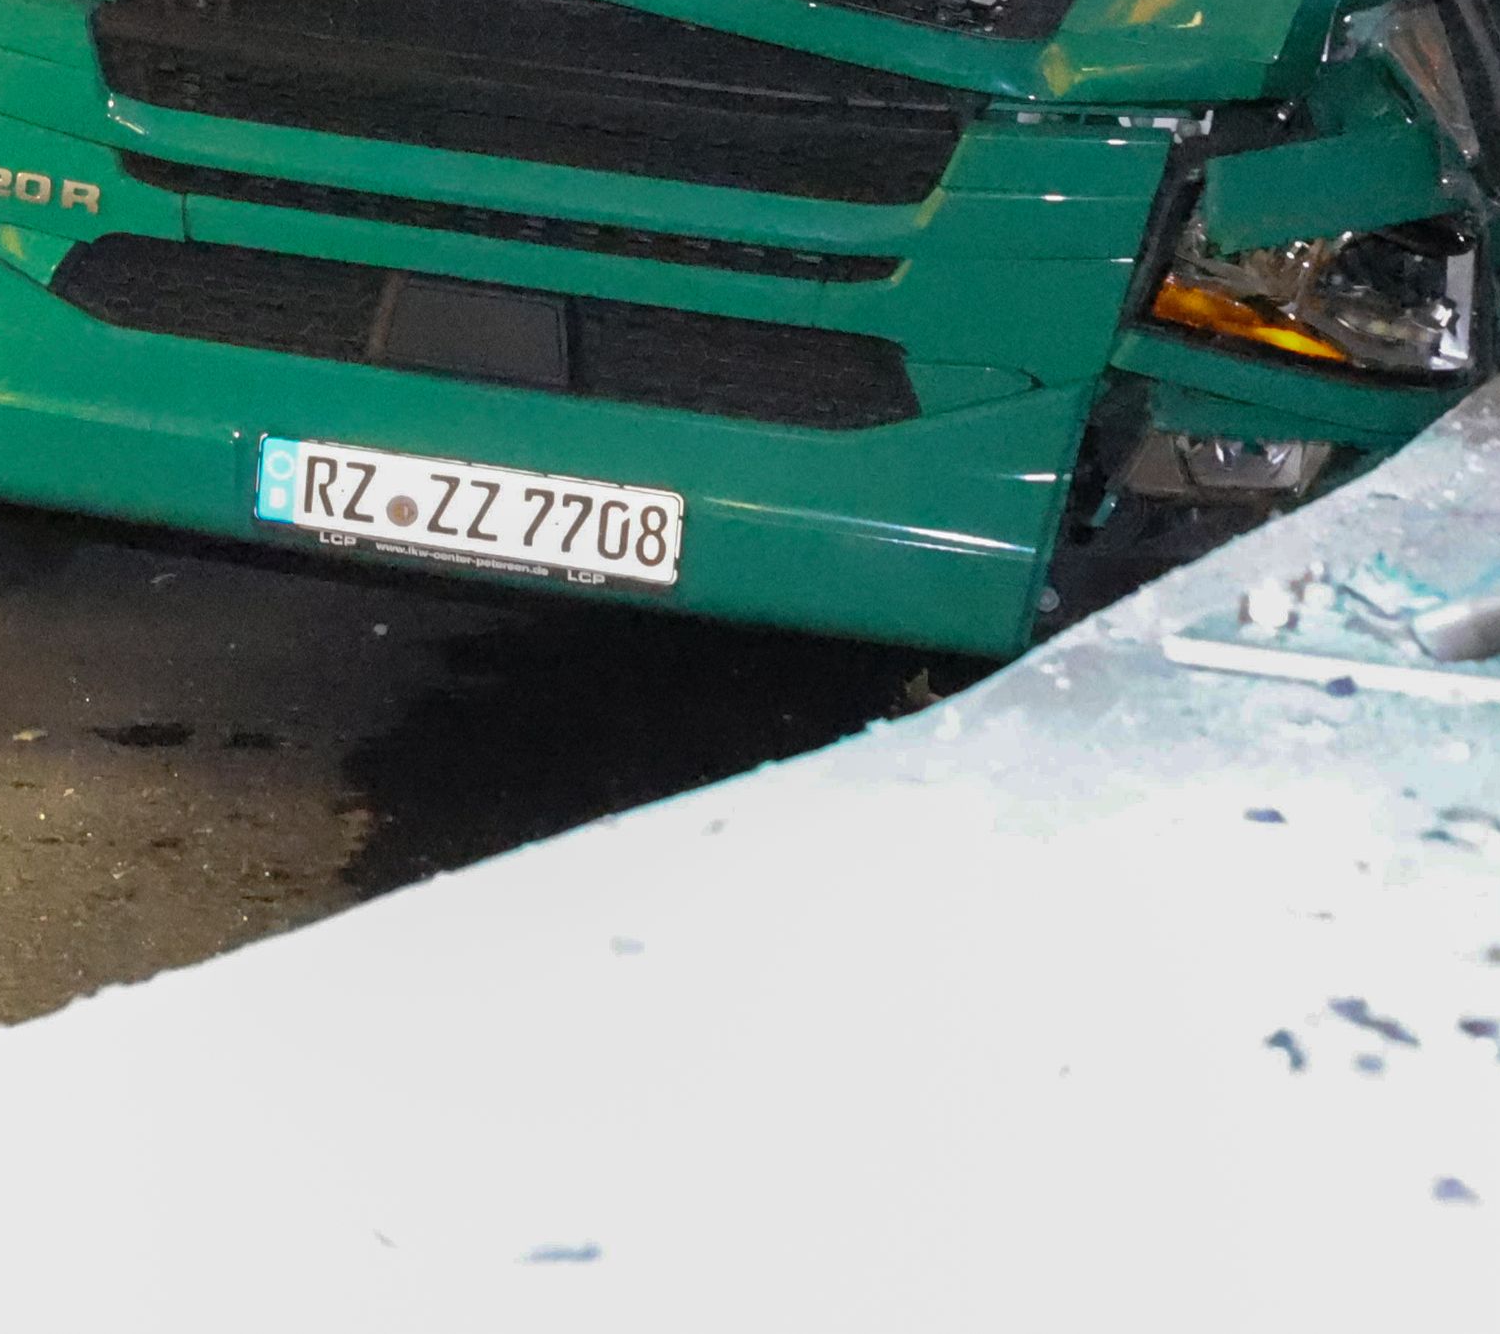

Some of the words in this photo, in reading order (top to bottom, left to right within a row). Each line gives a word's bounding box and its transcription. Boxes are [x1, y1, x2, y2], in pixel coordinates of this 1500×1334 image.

[61, 179, 100, 215] R
[303, 455, 377, 523] RZ
[426, 473, 502, 542] ZZ
[523, 487, 669, 567] 7708
[319, 530, 358, 548] LCP
[566, 567, 607, 586] LCP
